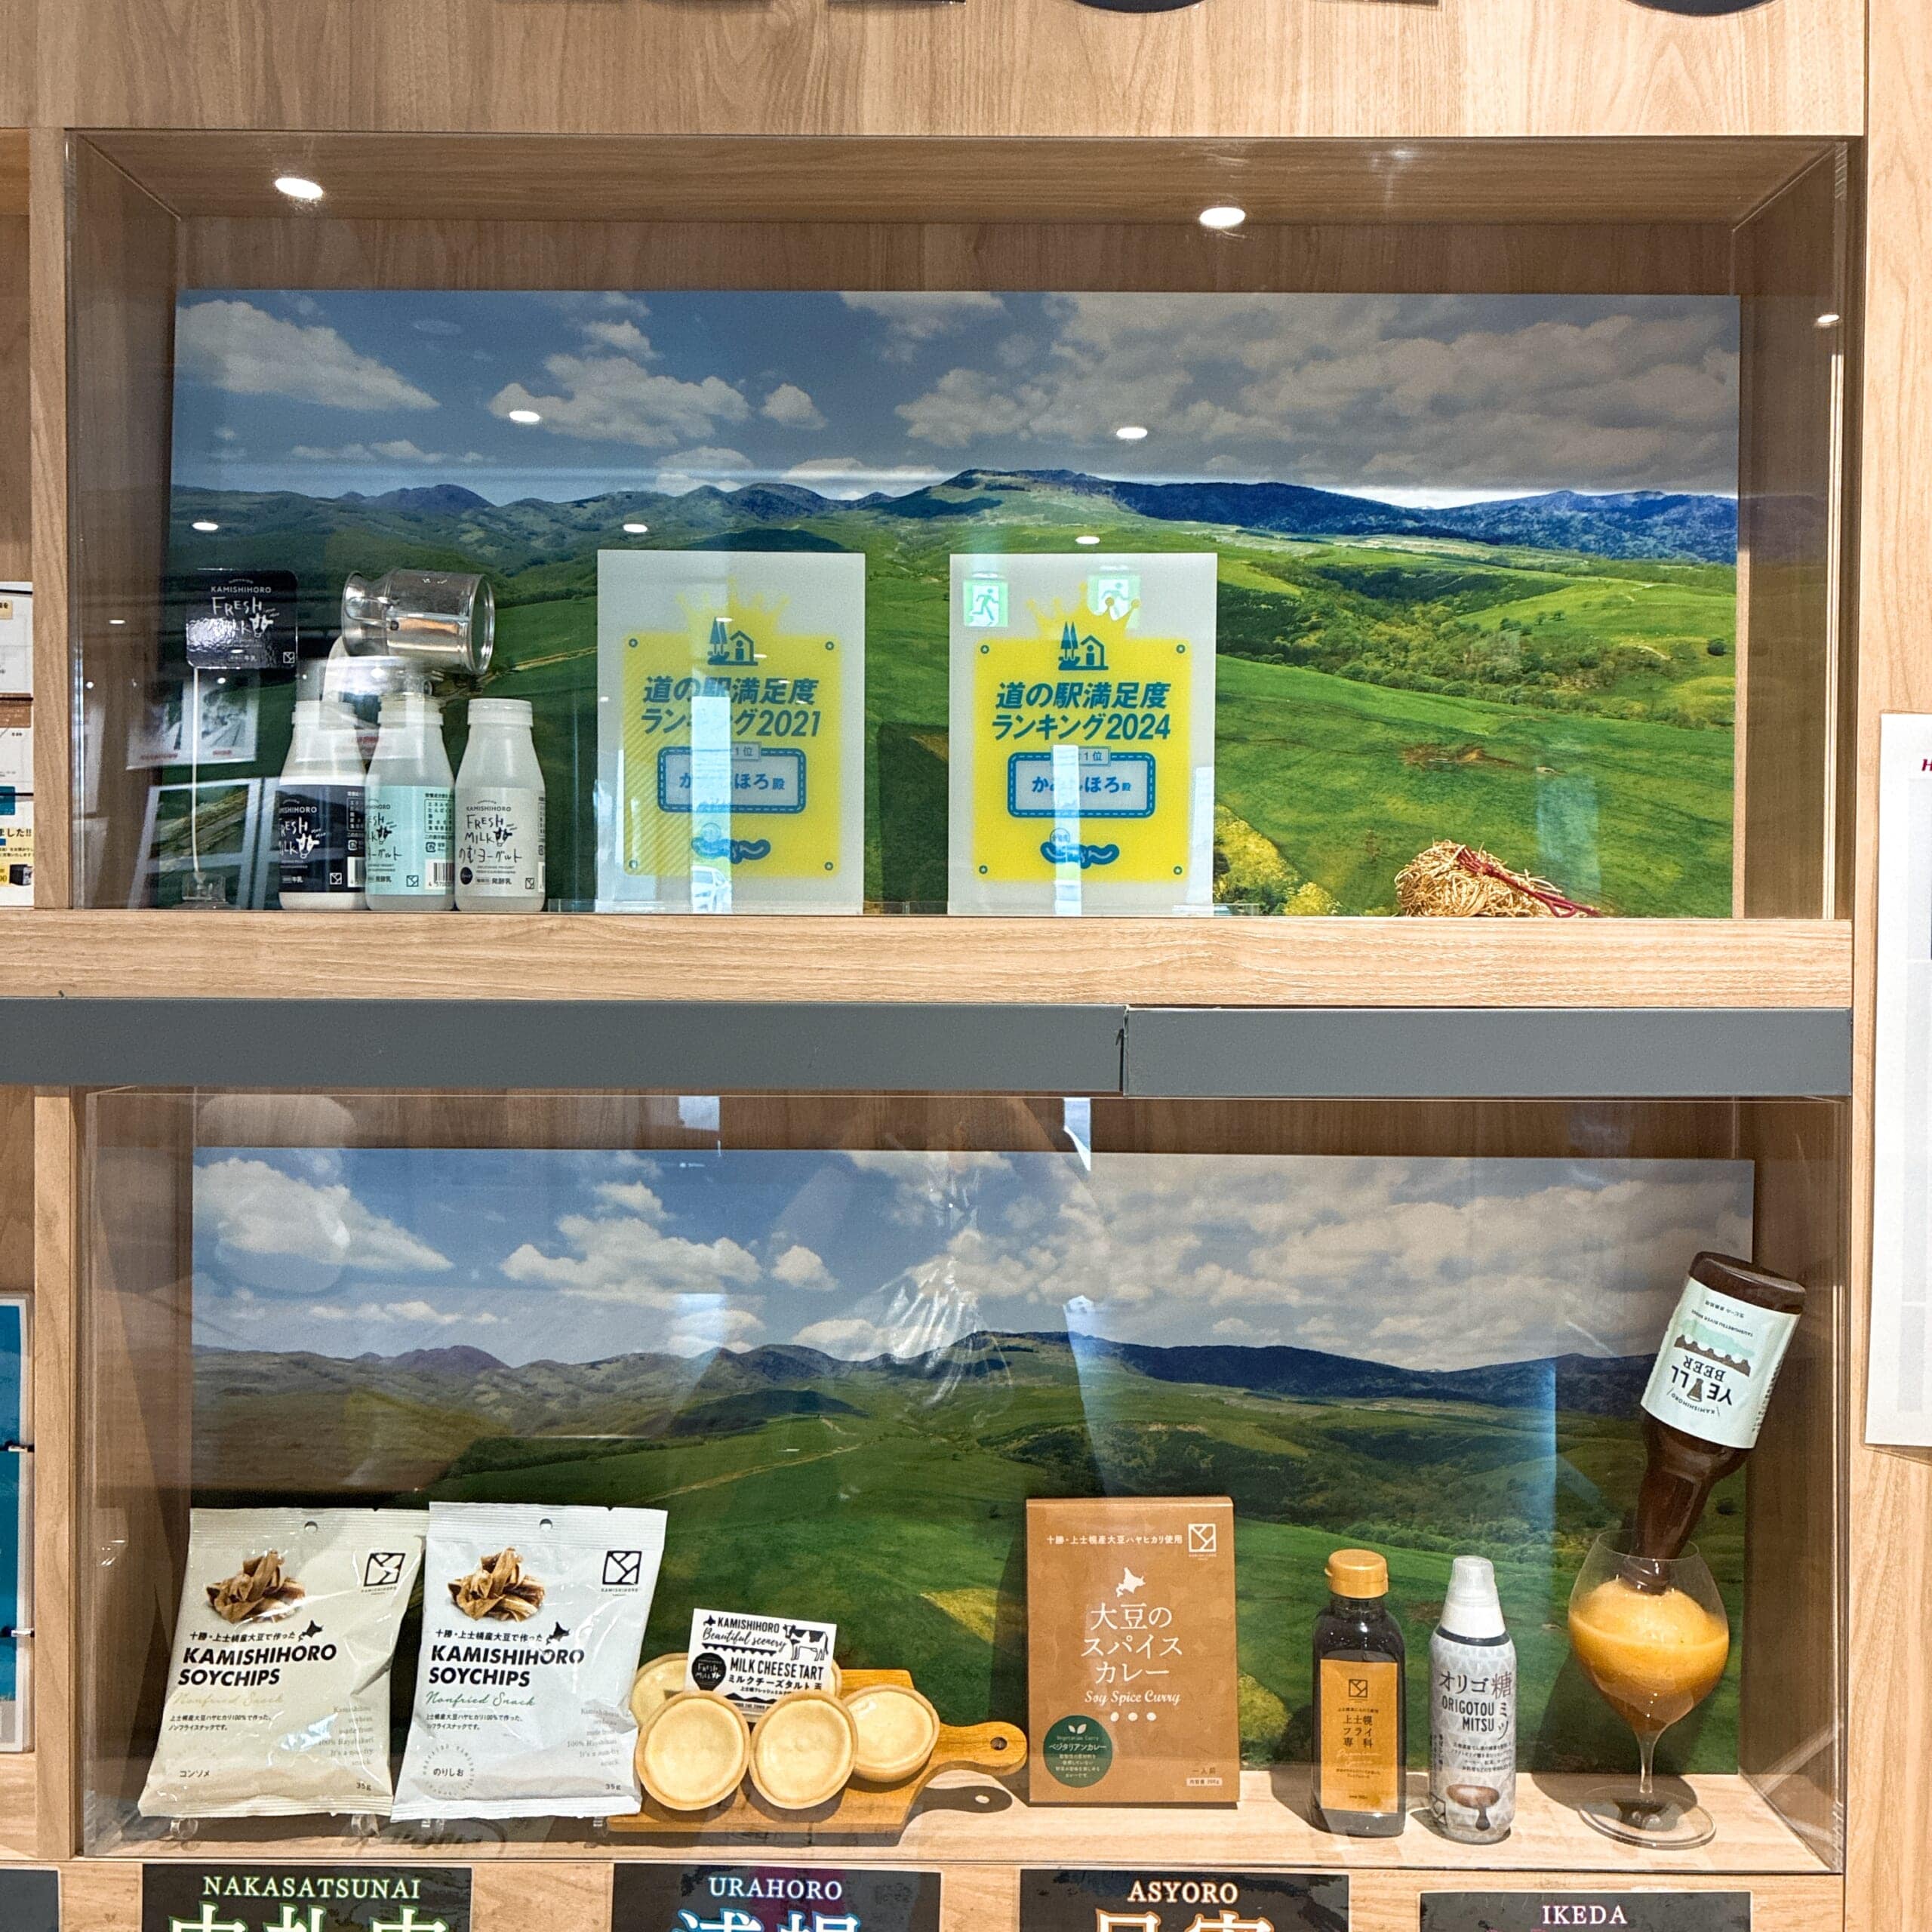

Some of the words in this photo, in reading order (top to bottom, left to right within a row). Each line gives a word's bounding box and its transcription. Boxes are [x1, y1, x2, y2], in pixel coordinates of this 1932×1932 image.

[211, 596, 263, 616] FRESH
[643, 676, 820, 705] 道の駅満足度
[995, 681, 1171, 709] 道の駅満足度
[641, 709, 821, 737] ラング2021
[992, 712, 1171, 740] ランキング2024
[466, 814, 504, 829] FRESH
[464, 832, 495, 844] MILK
[1683, 1355, 1727, 1383] BEER
[1671, 1392, 1715, 1415] KAMISHIHORO
[718, 1617, 780, 1633] KAMISHIHORO
[1090, 1601, 1172, 1631] 大豆の
[702, 1627, 751, 1645] Beautiful
[751, 1638, 787, 1654] scenery
[1080, 1634, 1183, 1660] スパイス
[183, 1644, 337, 1666] KAMISHIHORO
[431, 1644, 585, 1666] KAMISHIHORO
[177, 1668, 281, 1687] SOYCHIPS
[428, 1666, 531, 1687] SOYCHIPS
[730, 1657, 755, 1673] MILK
[757, 1660, 797, 1678] CHEESE
[798, 1664, 824, 1681] TART
[1095, 1661, 1170, 1684] カレー
[728, 1674, 810, 1690] ミルクチーズタルト
[1438, 1670, 1512, 1700] オリゴ糖
[425, 1690, 490, 1707] Nonfried
[492, 1691, 537, 1707] Snack
[1084, 1690, 1108, 1706] Soy
[1111, 1690, 1142, 1706] Spice
[1144, 1689, 1181, 1706] Curry
[1441, 1694, 1494, 1717] ORIGOTOU
[1343, 1714, 1373, 1726] 上士幌
[1462, 1717, 1494, 1732] MITSU
[1343, 1727, 1372, 1737] フライ
[179, 1770, 211, 1778] コンソメ
[433, 1767, 464, 1777] のりしお
[202, 1875, 420, 1899] NAKASATSUNAI
[709, 1877, 842, 1900] URAHORO
[1127, 1879, 1239, 1904] ASYORO
[1542, 1905, 1628, 1924] IKEDA
